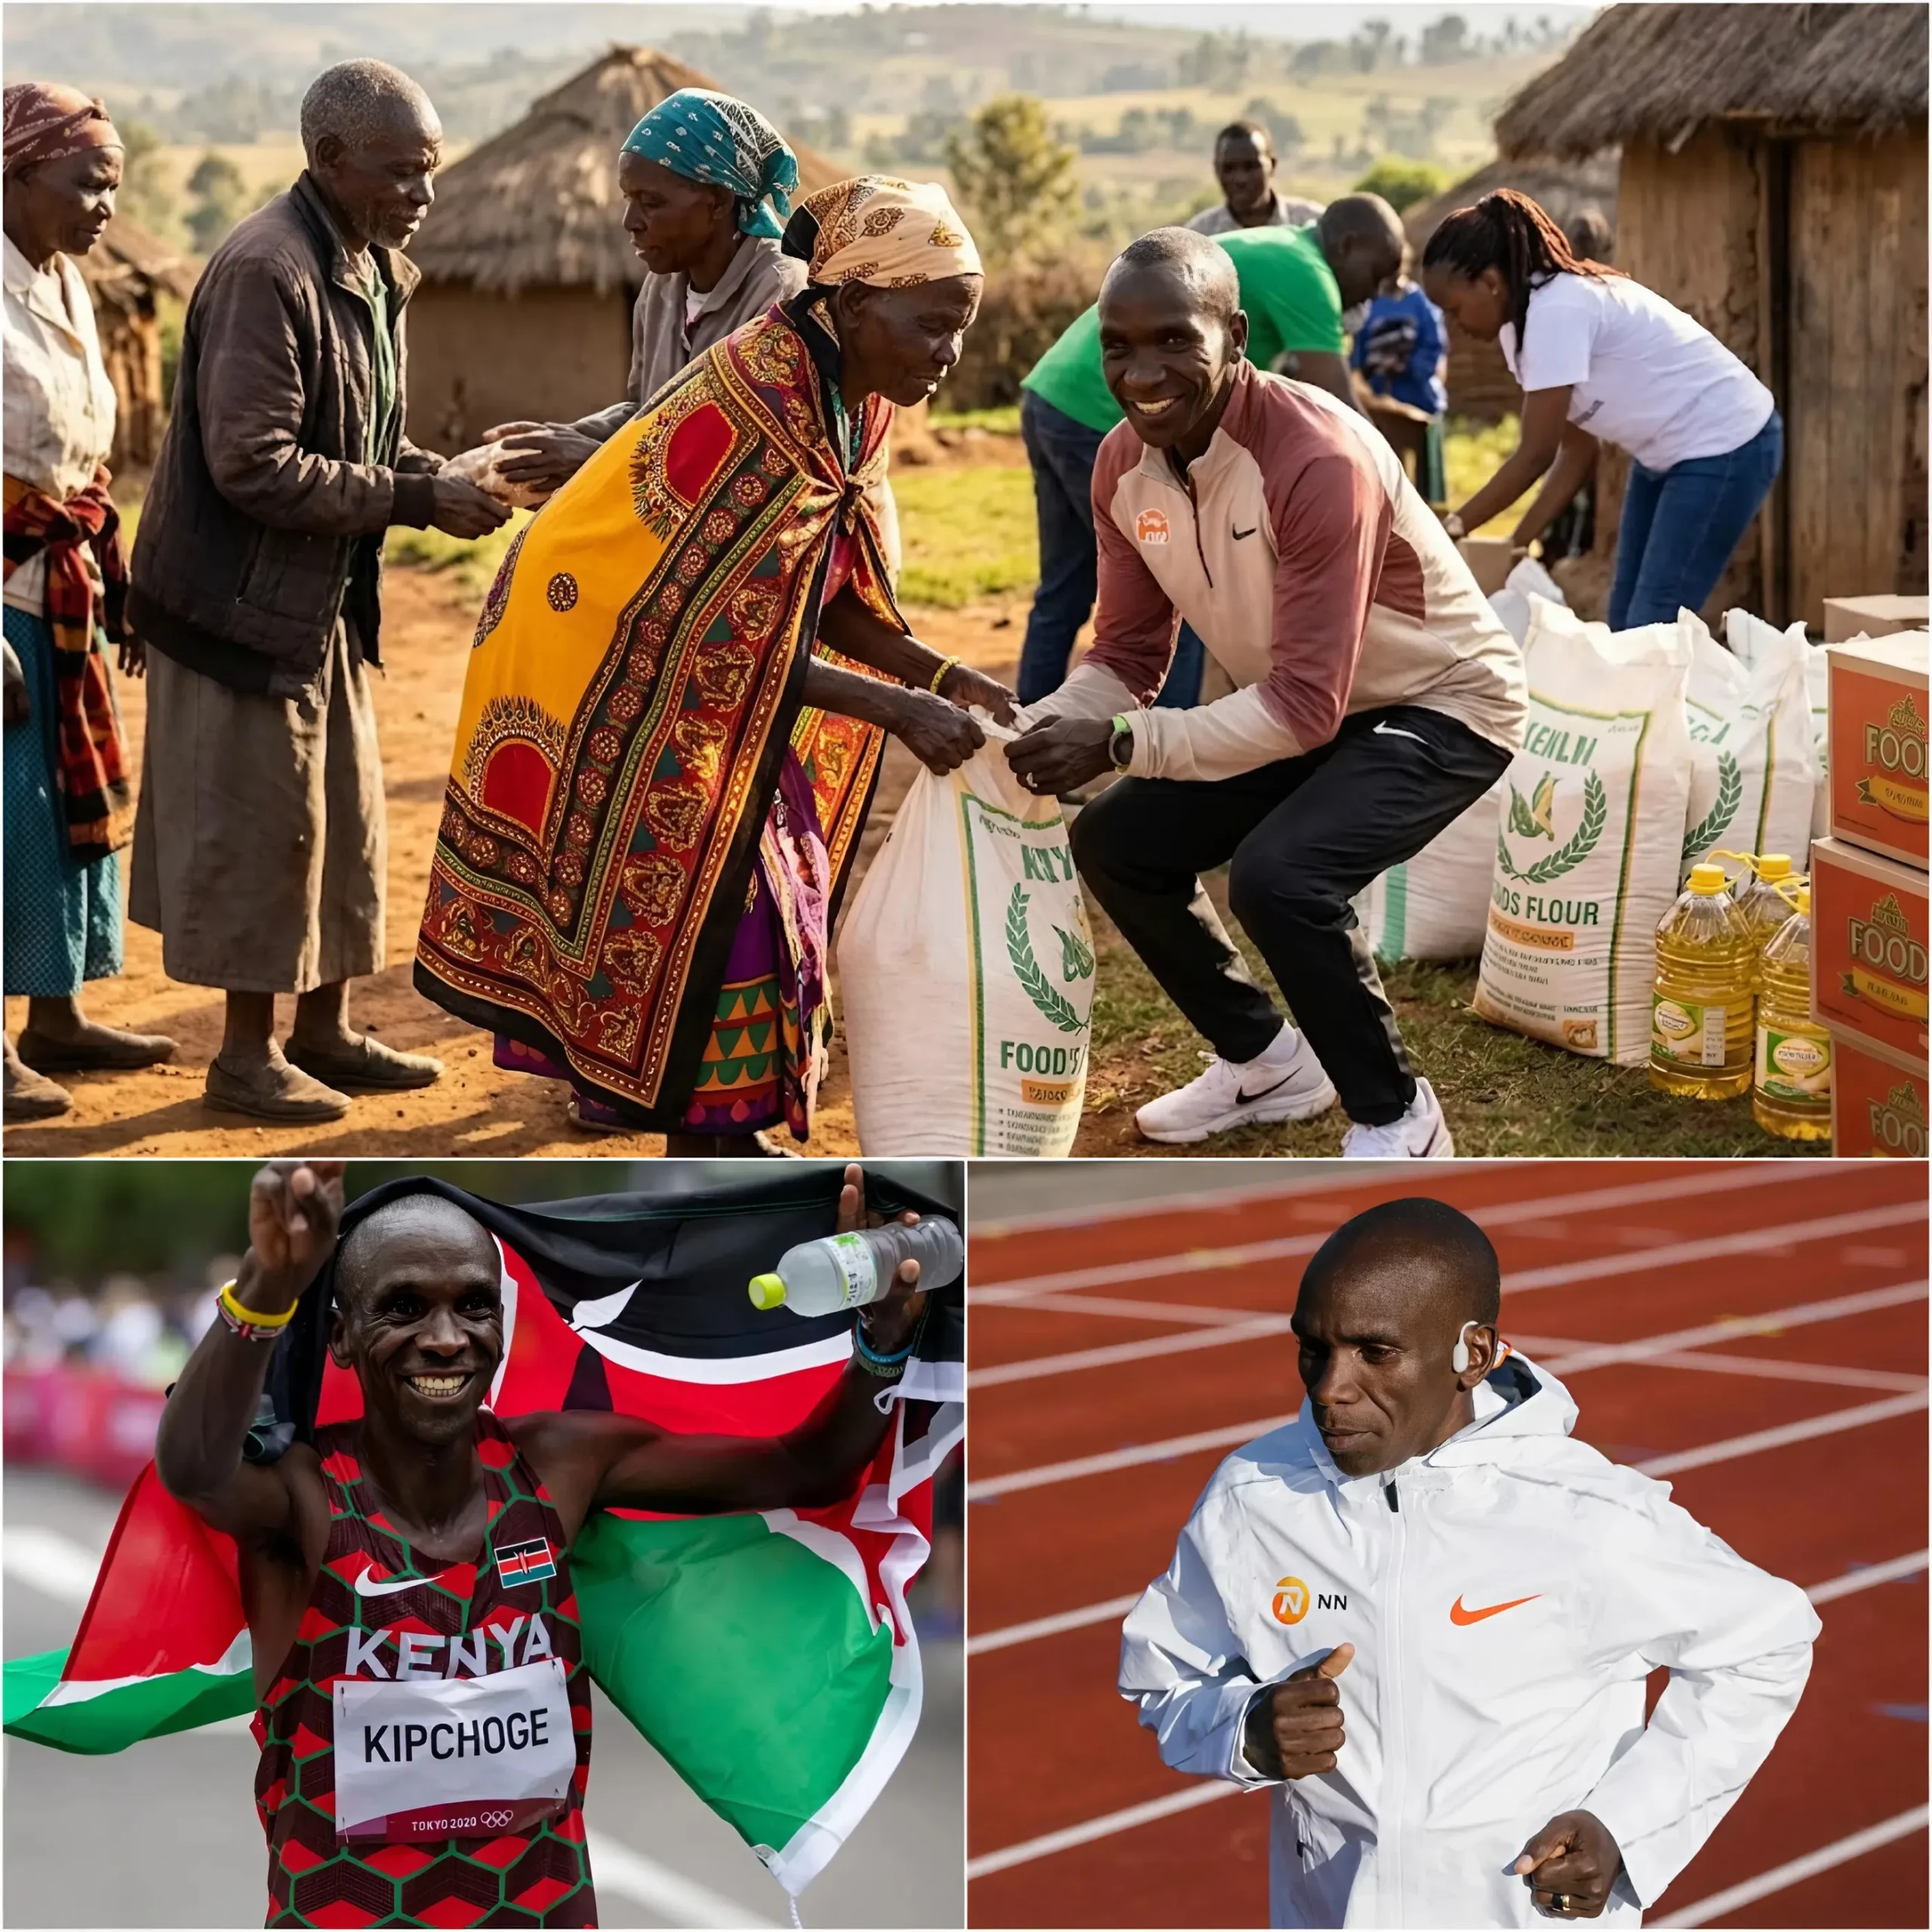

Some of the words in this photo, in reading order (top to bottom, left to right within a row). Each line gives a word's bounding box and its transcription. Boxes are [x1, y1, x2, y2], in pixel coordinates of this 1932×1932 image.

[1866, 724, 1929, 780] FOO
[1526, 895, 1599, 925] FLOUR
[1850, 920, 1929, 981] FOOD
[1869, 1104, 1929, 1157] FOO
[1318, 1594, 1347, 1611] NN
[345, 1613, 554, 1680] KENYA
[364, 1707, 549, 1763] KIPCHOGE
[411, 1819, 448, 1832] TOKYO
[450, 1817, 477, 1829] 2020
